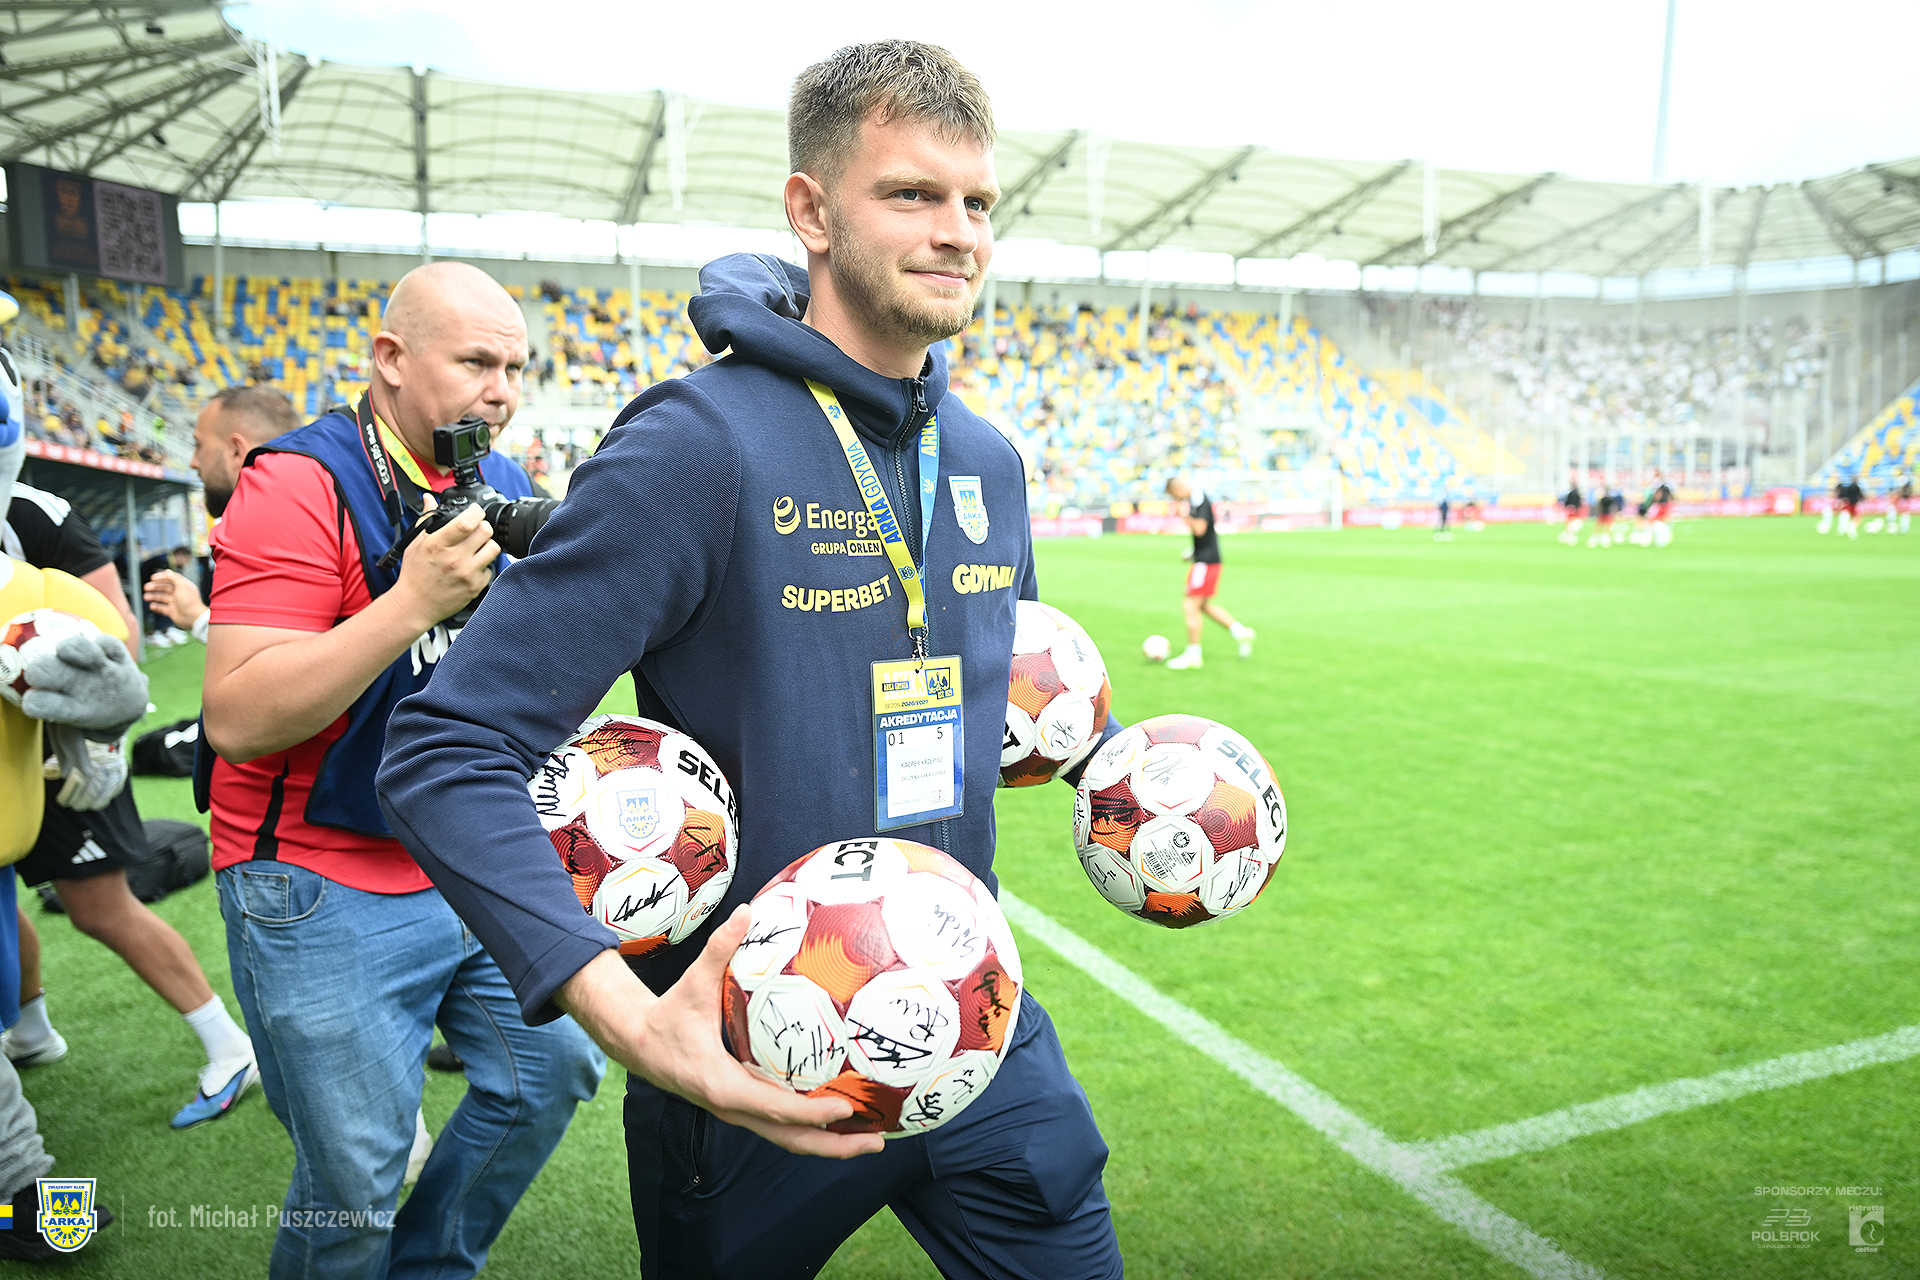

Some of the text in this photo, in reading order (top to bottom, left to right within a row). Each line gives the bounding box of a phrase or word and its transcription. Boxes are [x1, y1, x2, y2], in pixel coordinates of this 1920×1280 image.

[920, 415, 937, 457] ARKA
[376, 458, 389, 485] EOS
[847, 441, 902, 543] ARKA GDYNIA
[811, 542, 880, 555] GRUPA ORLEN
[781, 574, 892, 612] SUPERBET
[880, 708, 958, 728] AKREDYTACJA
[936, 726, 944, 740] 5
[1217, 740, 1284, 843] SELECT
